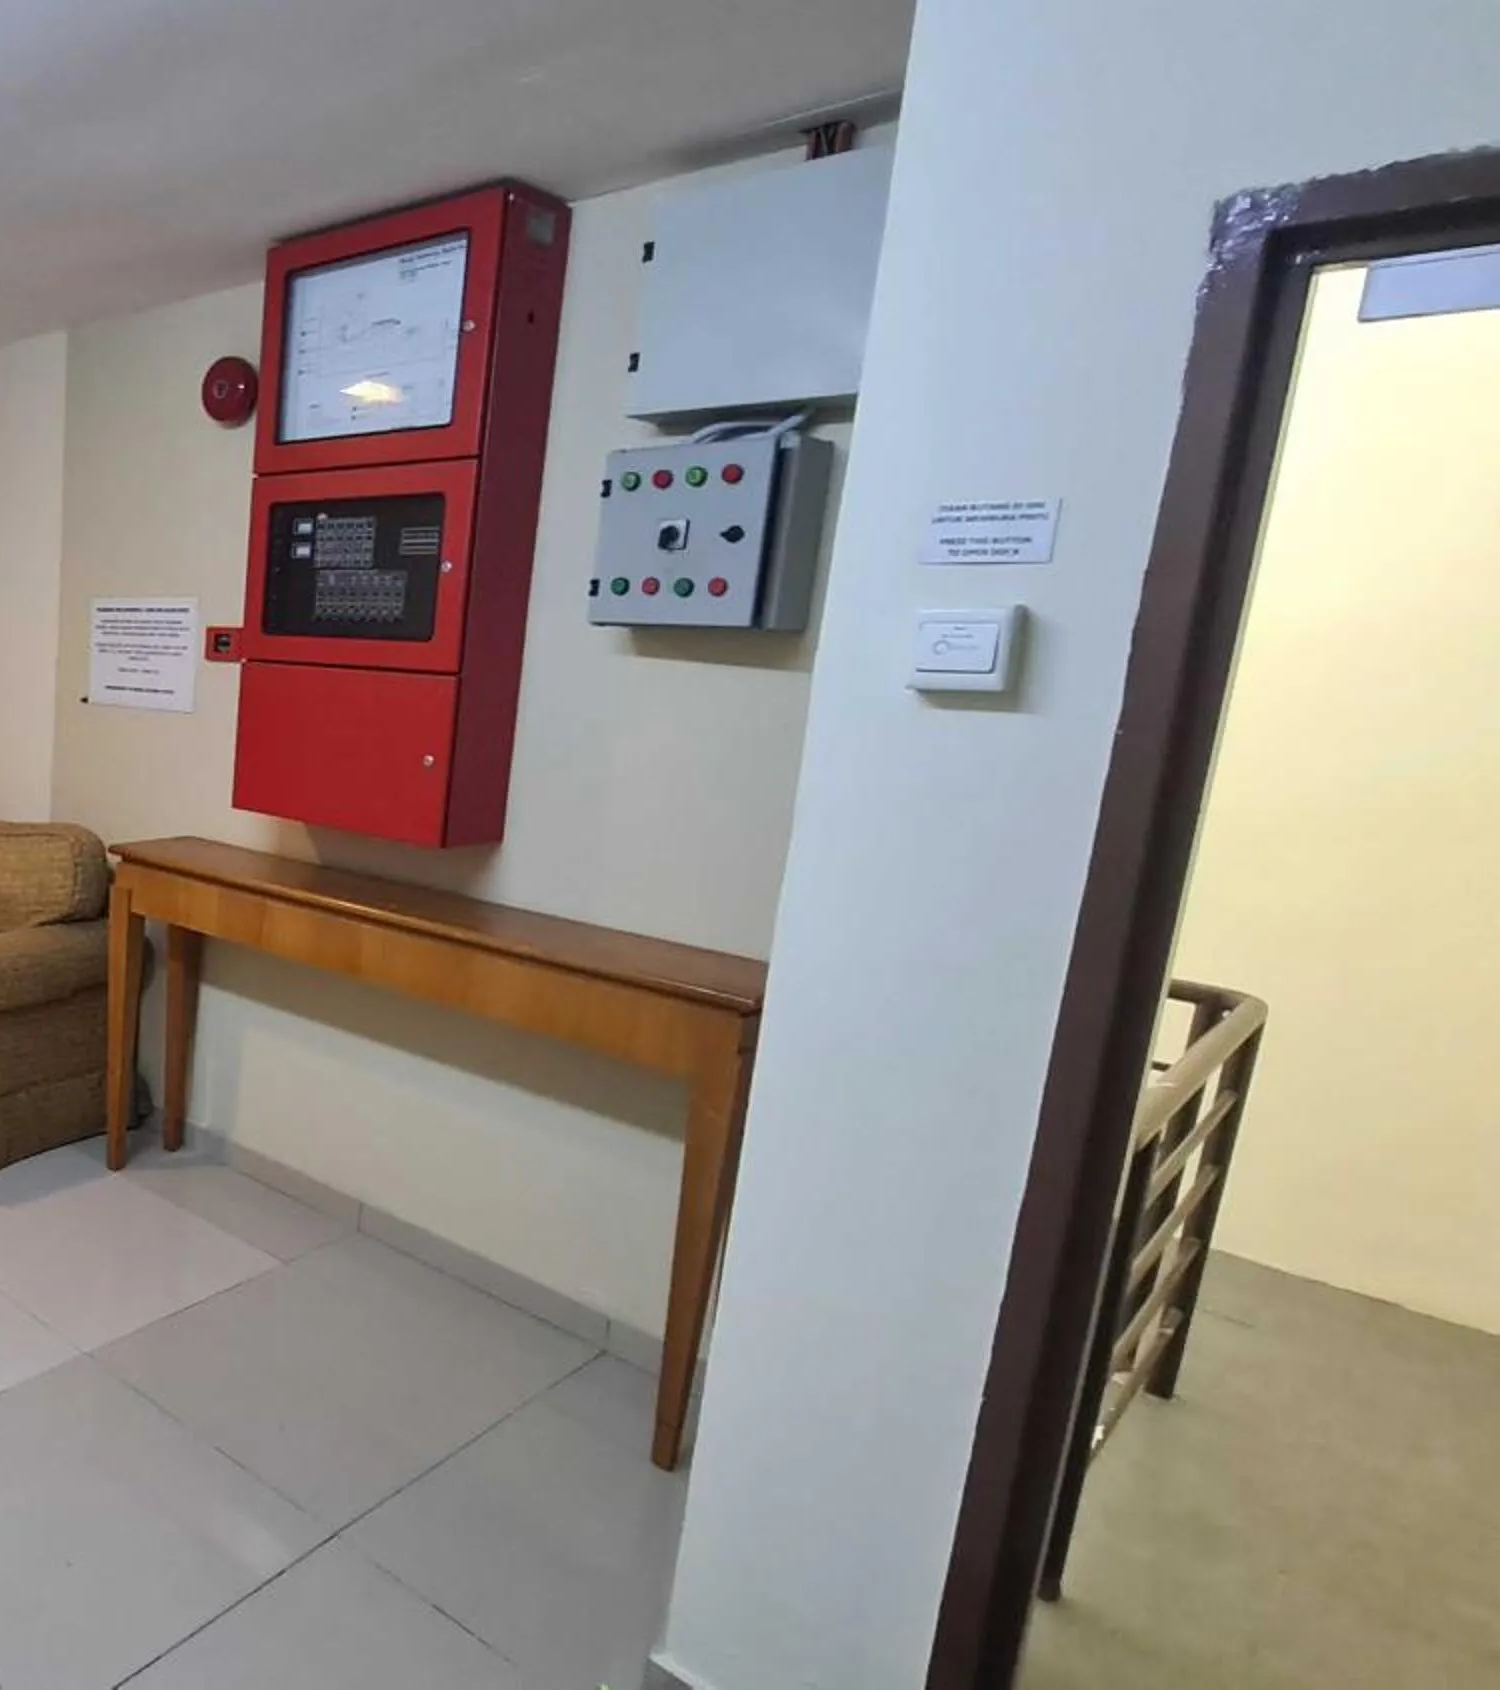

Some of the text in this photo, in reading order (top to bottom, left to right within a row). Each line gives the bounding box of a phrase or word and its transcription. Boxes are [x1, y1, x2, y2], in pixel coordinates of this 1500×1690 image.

[992, 536, 1032, 544] BUTTON
[948, 548, 960, 556] TO
[962, 548, 988, 556] OPEN
